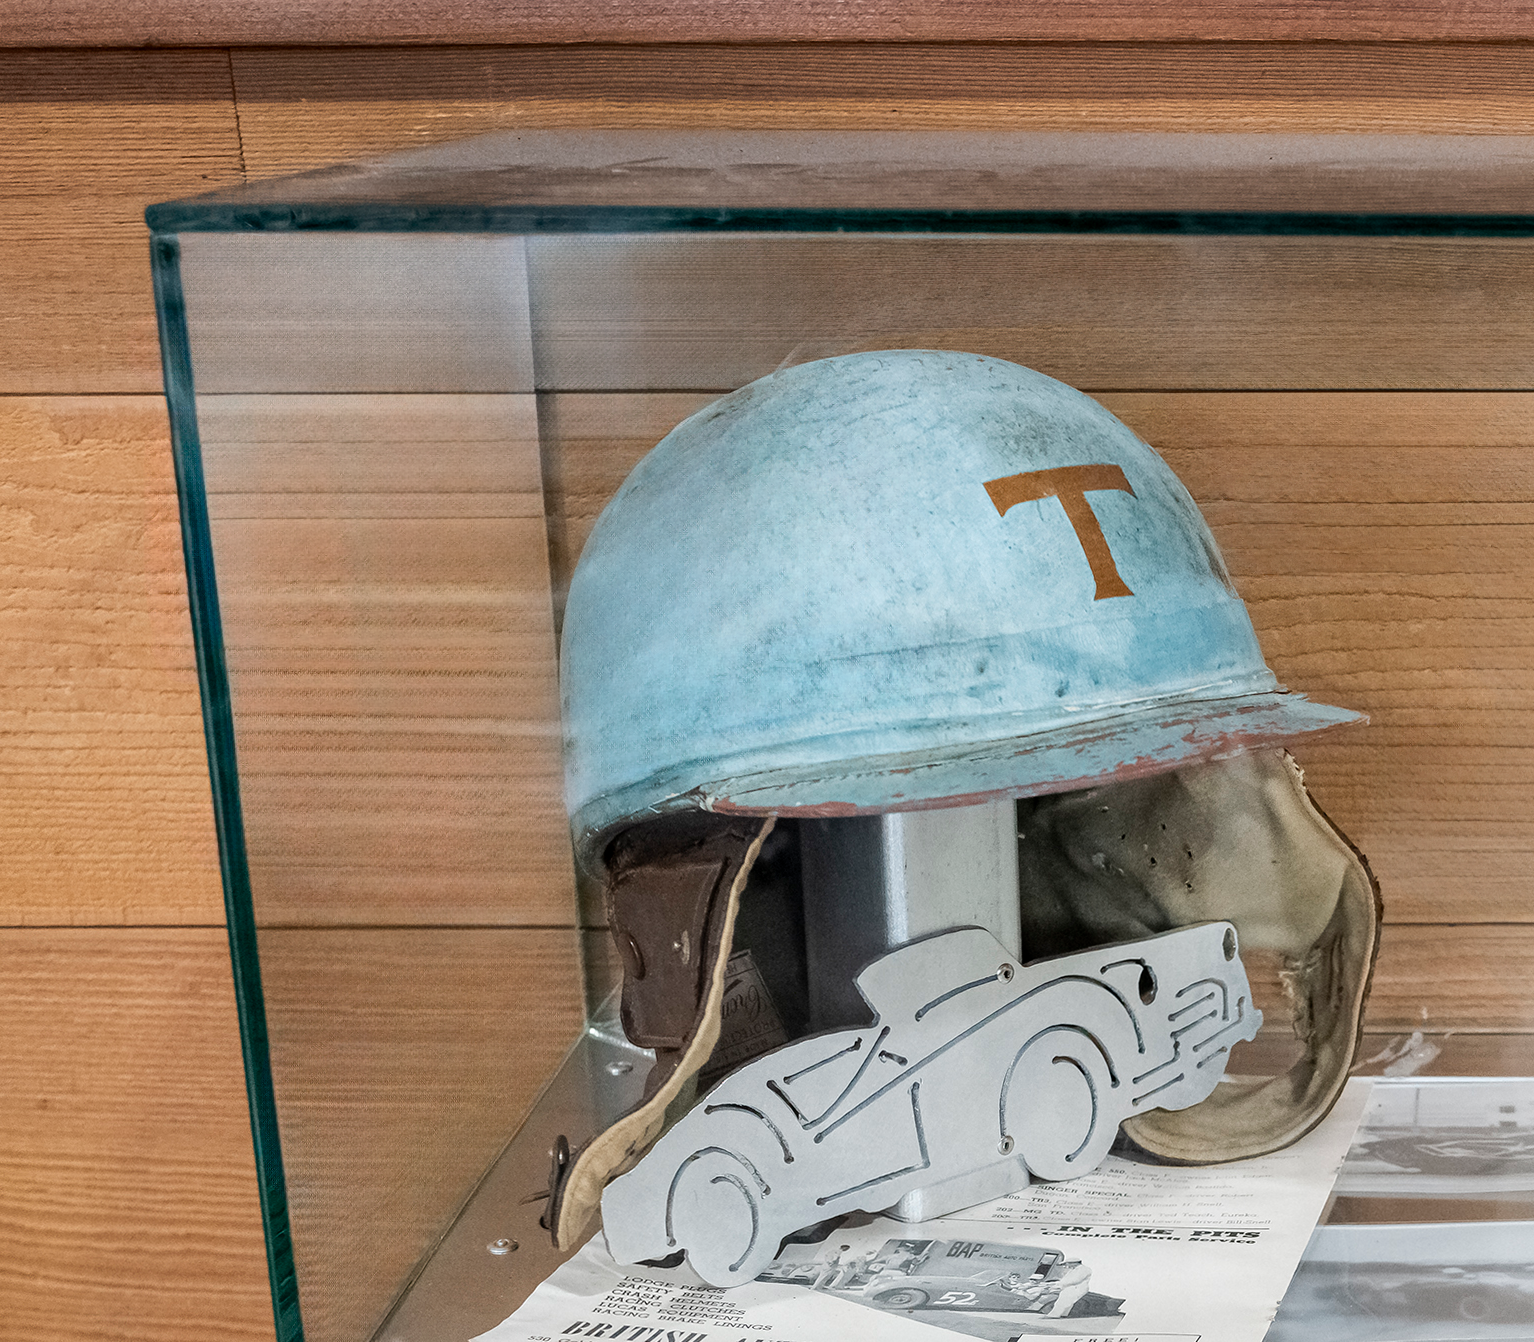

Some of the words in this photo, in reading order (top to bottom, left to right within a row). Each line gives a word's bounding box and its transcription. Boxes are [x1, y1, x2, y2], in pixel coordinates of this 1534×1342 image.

[982, 464, 1136, 601] T
[1041, 1231, 1127, 1239] Complete
[1188, 1237, 1256, 1245] Service
[1056, 1225, 1094, 1233] IN
[1111, 1227, 1175, 1235] THE
[1190, 1230, 1261, 1239] PITS
[946, 1241, 984, 1259] BAP
[616, 1282, 674, 1294] SAFETY
[682, 1292, 725, 1300] BELTS
[623, 1276, 676, 1288] LODGE
[679, 1285, 727, 1294] PLUGS
[604, 1295, 663, 1307] RACING
[670, 1304, 747, 1315] CLUTCHES
[611, 1289, 663, 1300] CRASH
[669, 1297, 736, 1308] HELMETS
[592, 1308, 650, 1319] RACING
[657, 1315, 707, 1325] BRAKE
[713, 1321, 773, 1331] LININGS
[598, 1301, 648, 1312] LUCAS
[657, 1309, 745, 1321] EQUIPMENT
